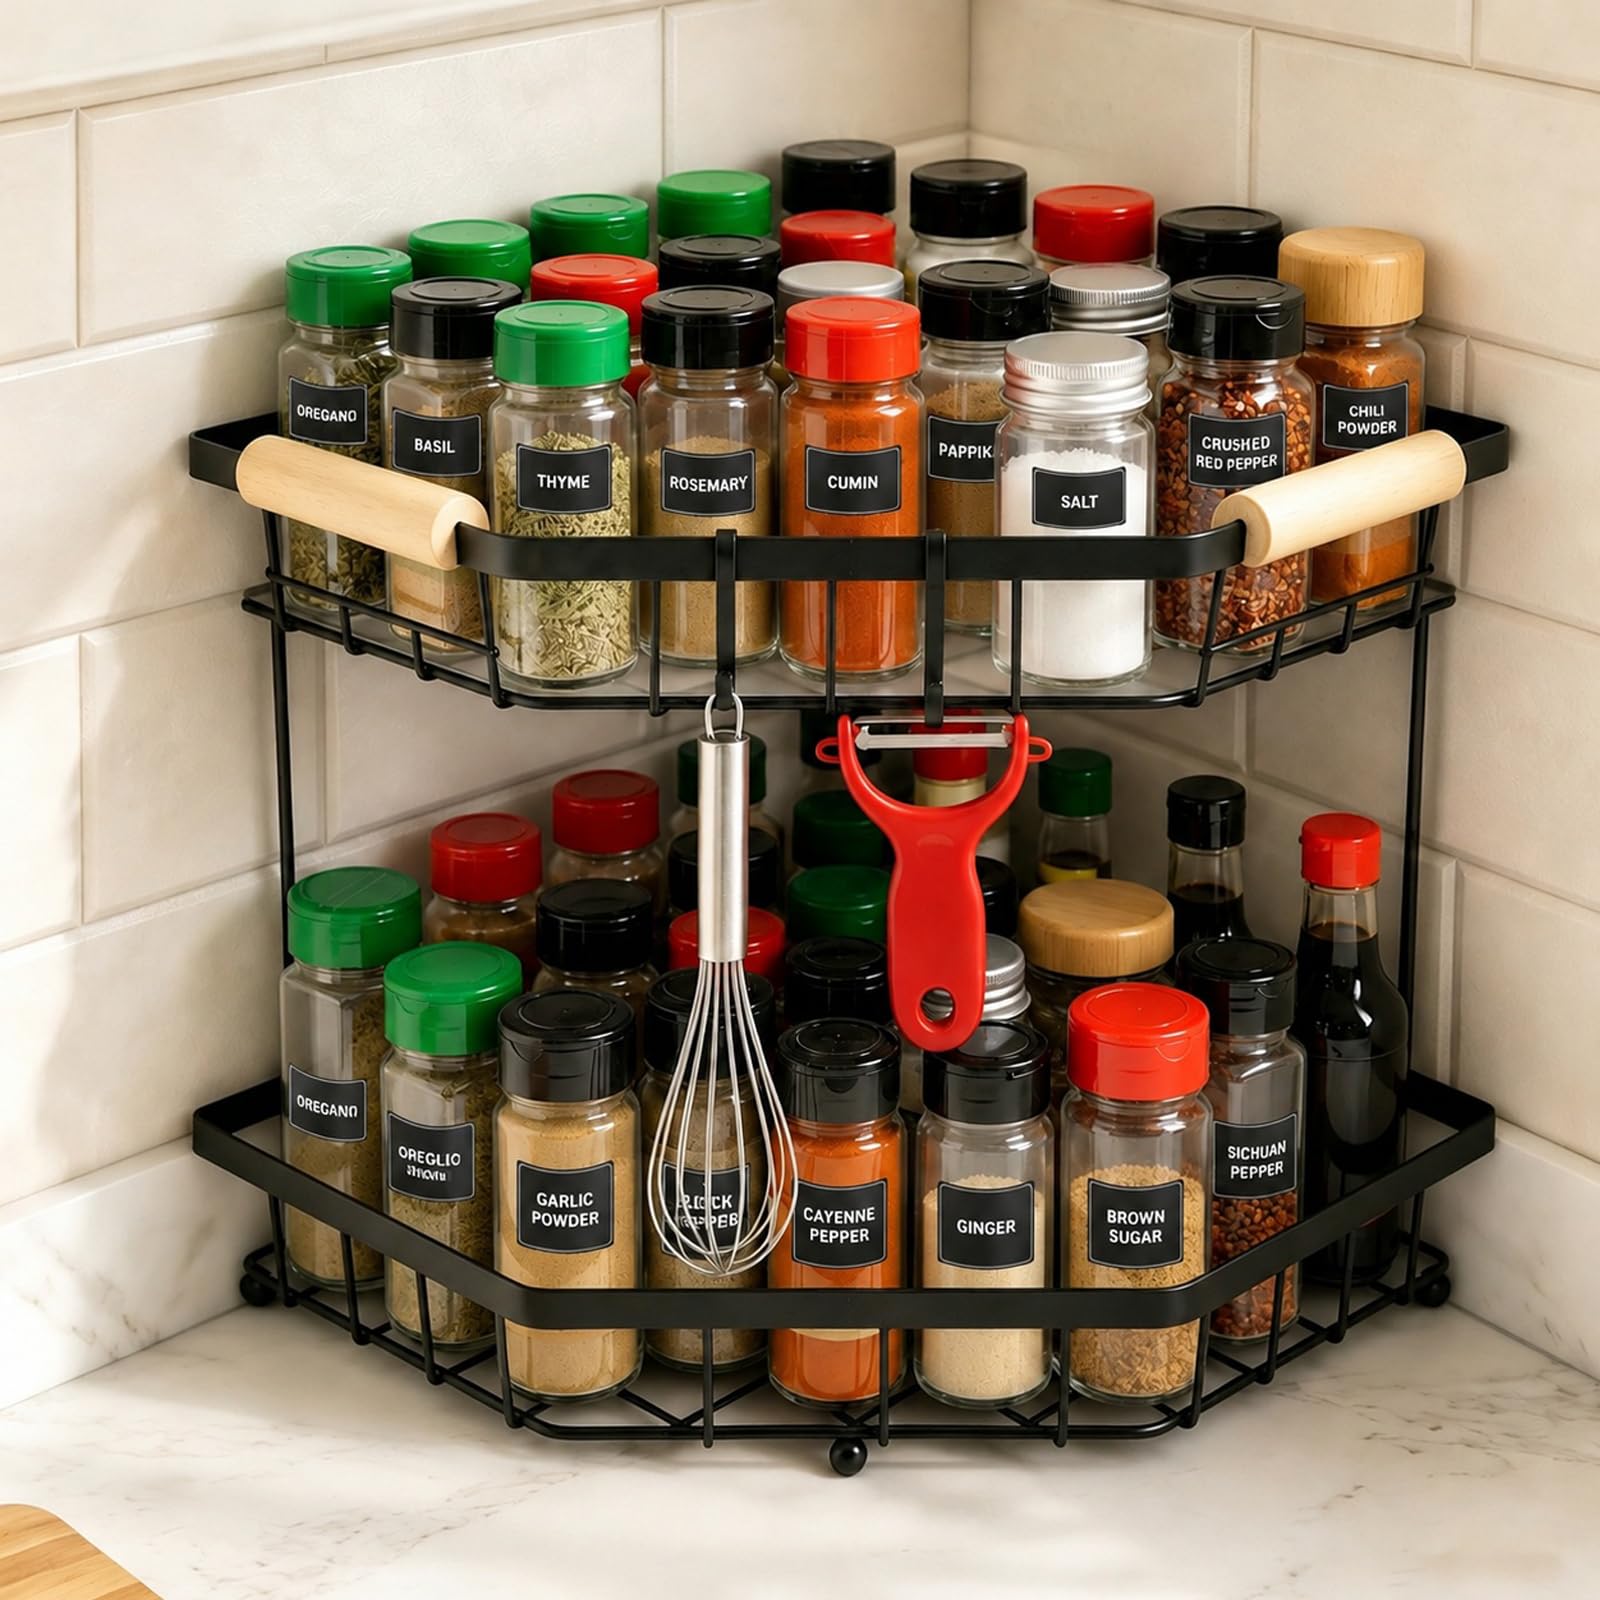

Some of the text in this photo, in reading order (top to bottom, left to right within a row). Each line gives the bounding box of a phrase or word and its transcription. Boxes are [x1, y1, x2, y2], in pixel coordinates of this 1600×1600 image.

[296, 403, 357, 422] OREGANO
[1348, 404, 1385, 418] CHILI
[1337, 420, 1397, 435] POWDER
[414, 437, 456, 454] BASIL
[938, 442, 994, 459] PAPPIK
[1201, 435, 1271, 452] CRUSHED
[1195, 453, 1278, 472] RED PEPPER
[536, 473, 590, 489] THYME
[669, 475, 749, 493] ROSEMARY
[827, 474, 879, 490] CUMIN
[1061, 494, 1099, 509] SALT
[398, 1145, 461, 1167] OREGLIO
[1227, 1139, 1287, 1161] SICHUAN
[1230, 1159, 1284, 1180] PEPPER
[536, 1191, 594, 1209] GARLIC
[531, 1210, 600, 1228] POWDER
[803, 1206, 876, 1225] CAYENNE
[1107, 1209, 1165, 1226] BROWN
[809, 1227, 870, 1244] PEPPER
[956, 1219, 1016, 1236] GINGER
[1109, 1228, 1163, 1245] SUGAR
